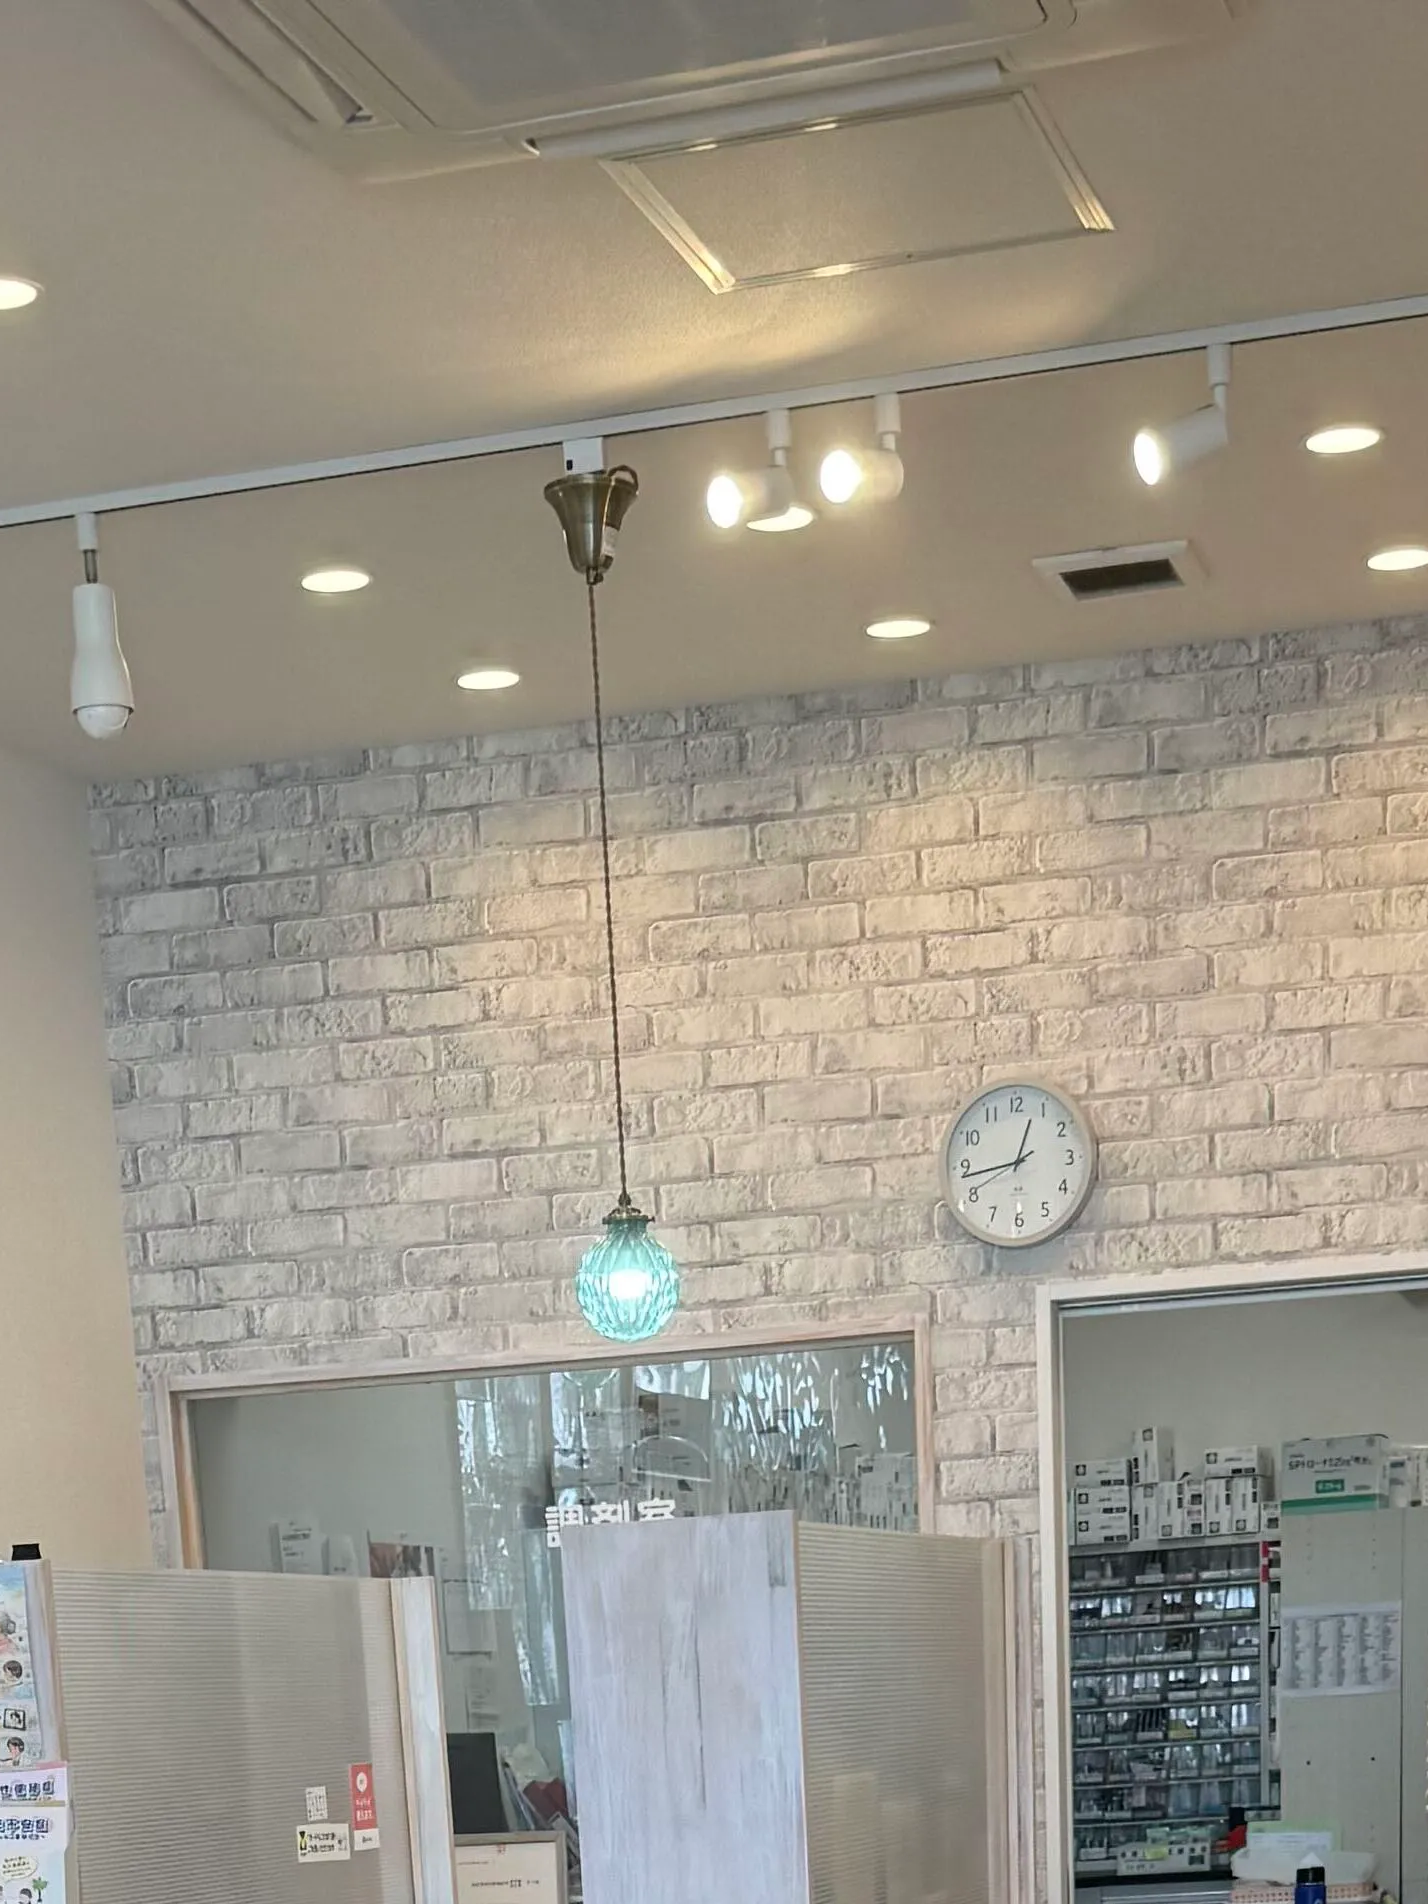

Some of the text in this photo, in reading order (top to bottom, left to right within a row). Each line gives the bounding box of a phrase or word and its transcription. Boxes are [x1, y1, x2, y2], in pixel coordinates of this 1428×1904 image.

[1009, 1096, 1023, 1113] 12
[985, 1106, 998, 1123] 11
[965, 1129, 980, 1146] 10
[1056, 1121, 1066, 1138] 2
[1064, 1149, 1074, 1165] 3
[960, 1158, 971, 1176] 9
[968, 1187, 979, 1203] 8
[1058, 1178, 1068, 1195] 4
[988, 1206, 997, 1222] 7
[1041, 1201, 1050, 1217] 5
[1014, 1211, 1024, 1228] 6
